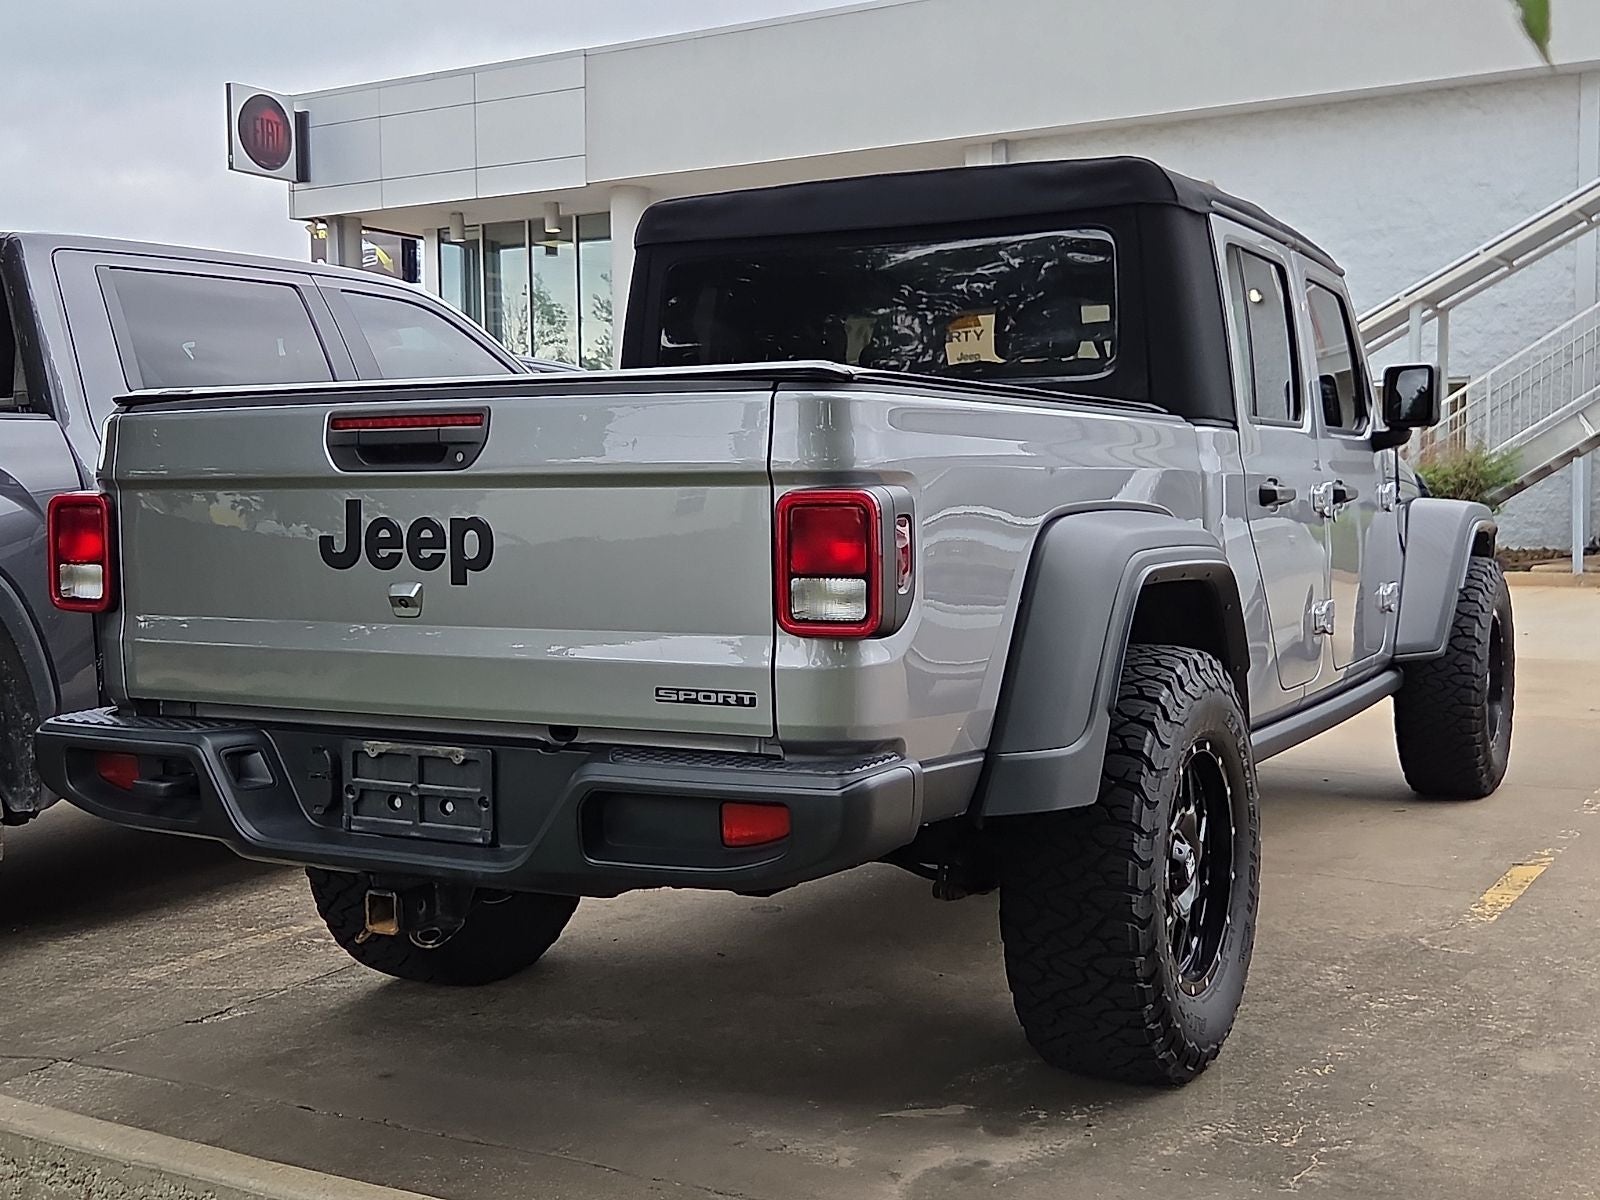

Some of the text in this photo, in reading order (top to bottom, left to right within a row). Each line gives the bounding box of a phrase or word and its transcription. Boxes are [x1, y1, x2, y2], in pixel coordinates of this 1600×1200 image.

[253, 117, 281, 151] FIAT
[957, 352, 981, 362] Jeep
[318, 499, 494, 585] Jeep
[657, 689, 757, 706] SPORT
